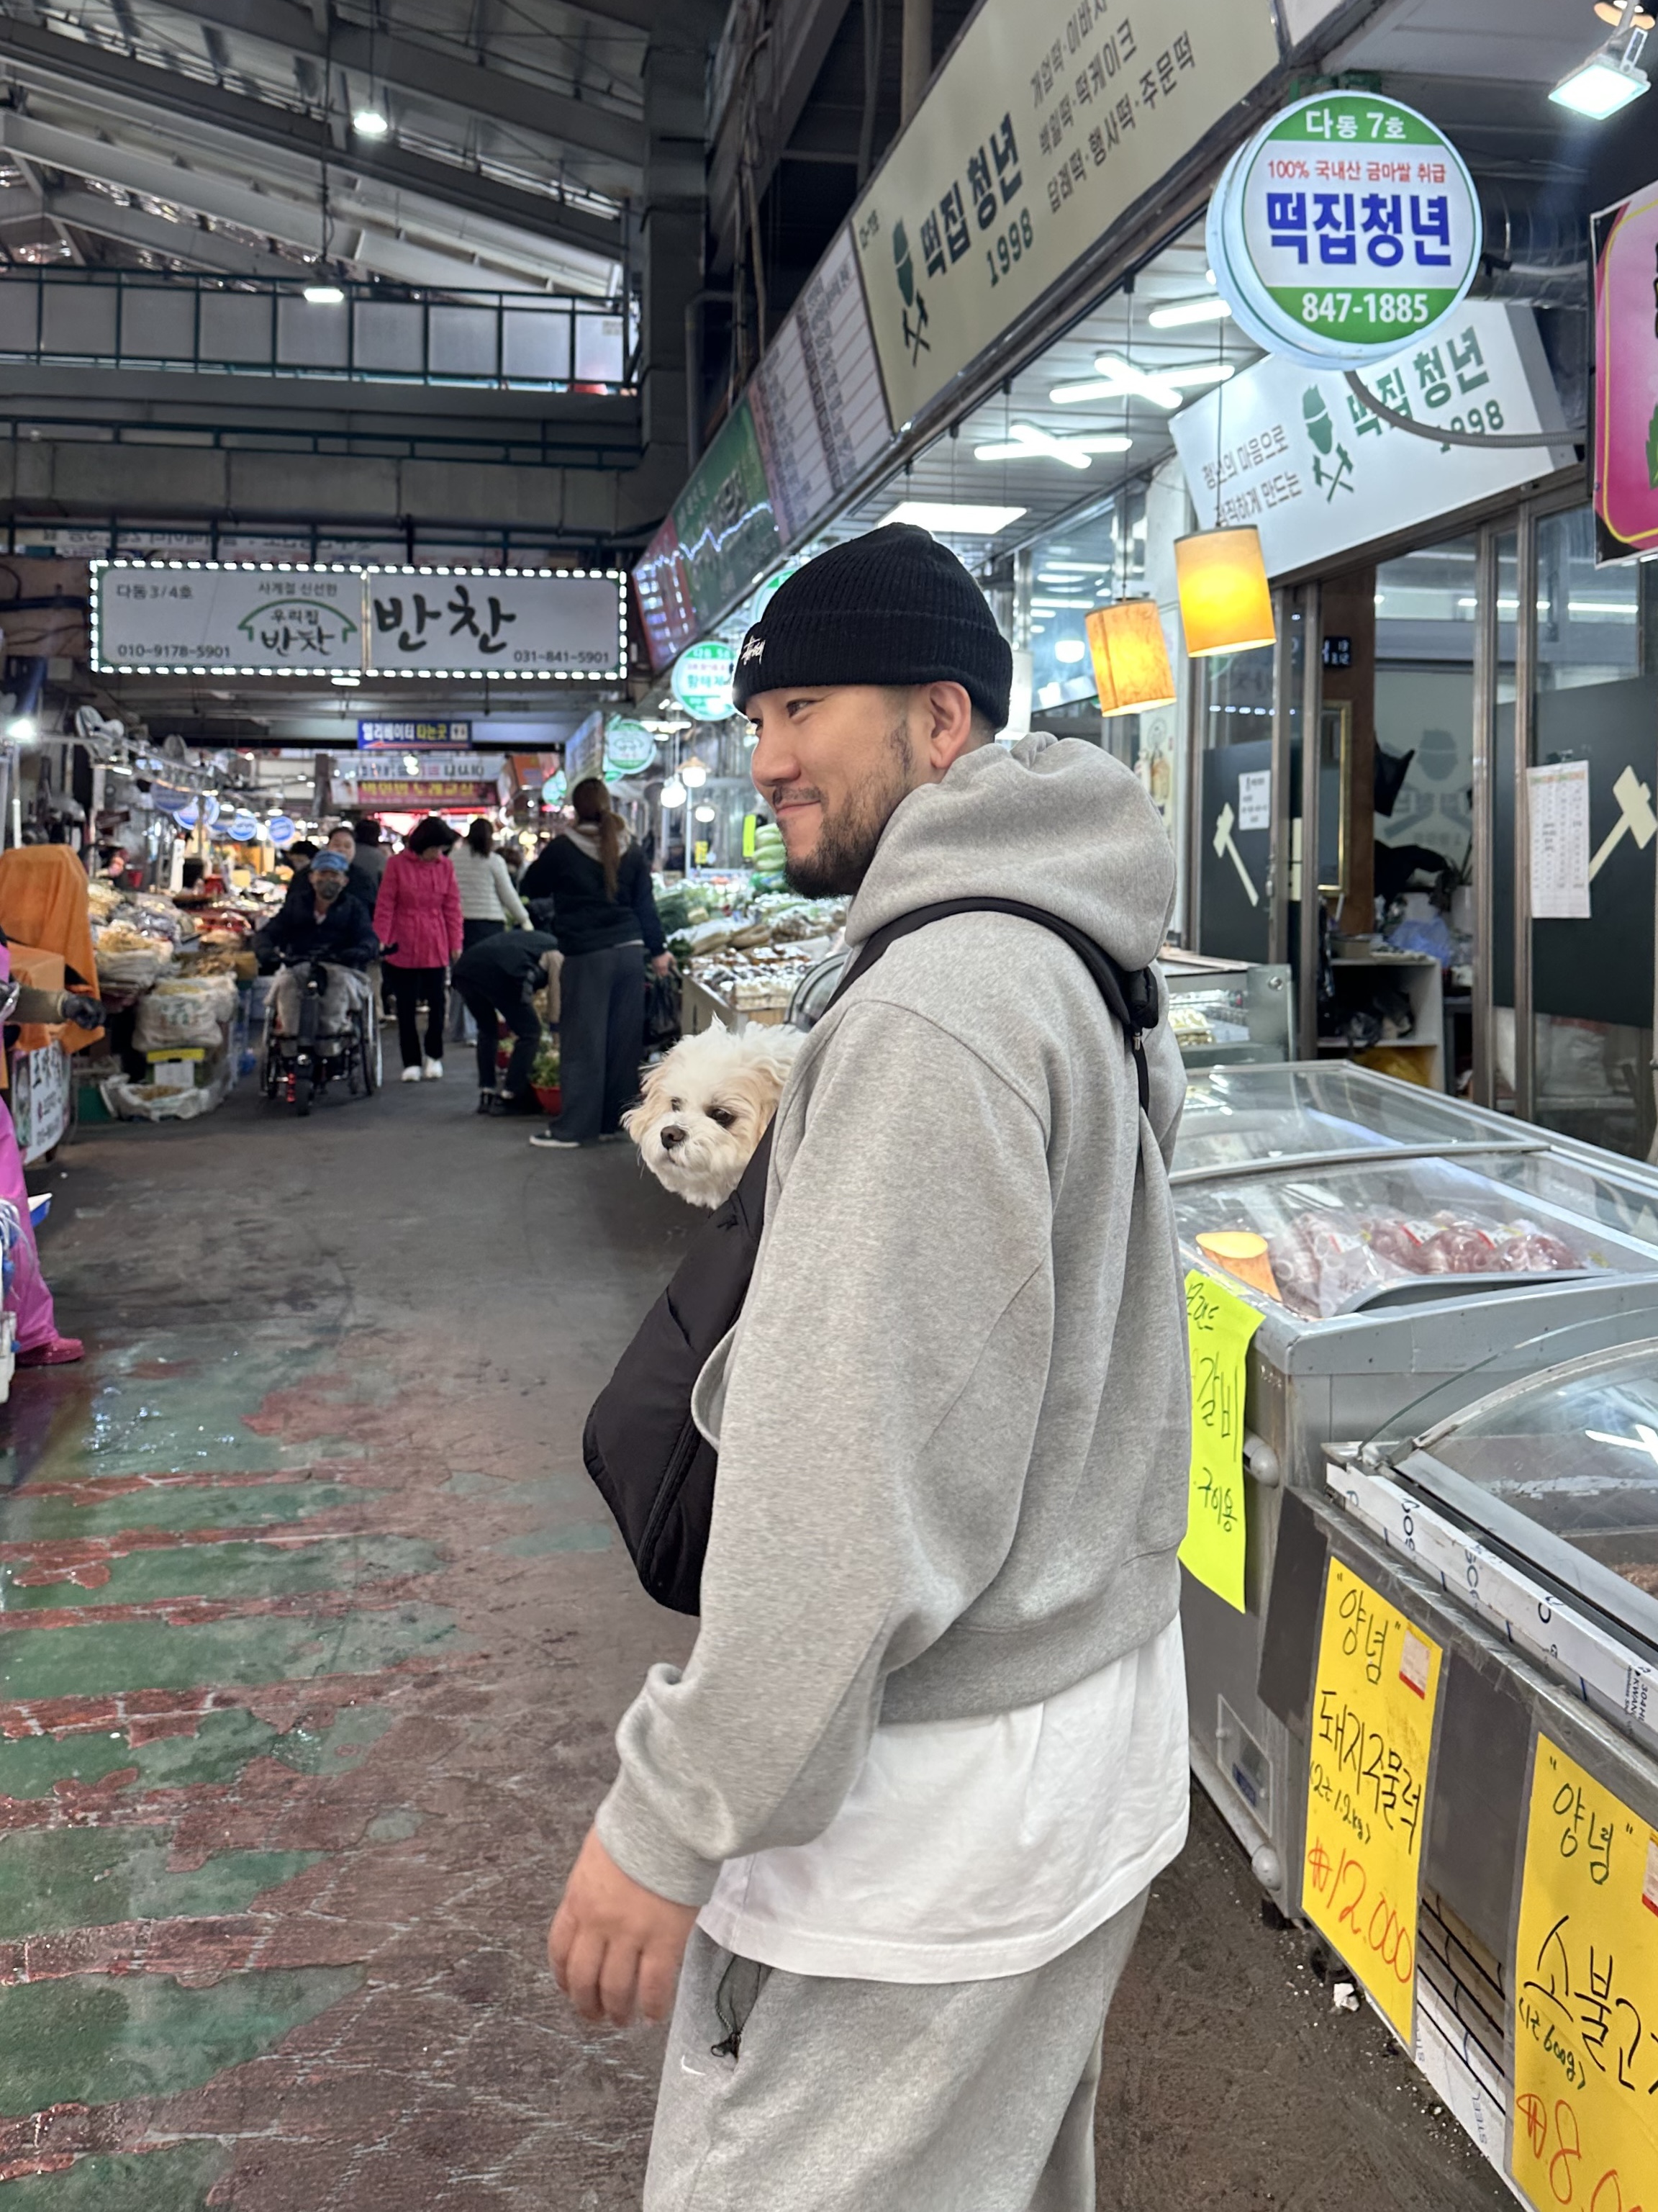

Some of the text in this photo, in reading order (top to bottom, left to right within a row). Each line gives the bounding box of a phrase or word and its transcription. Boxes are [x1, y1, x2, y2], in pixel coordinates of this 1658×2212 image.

[1305, 109, 1407, 139] 다동 7호
[1268, 160, 1446, 184] 100% 국내산 금마쌀 취급
[1267, 192, 1451, 267] 떡집청년
[986, 207, 1033, 288] 1998
[1302, 292, 1429, 323] 847-1885
[1440, 399, 1504, 453] 998
[1237, 424, 1289, 471] 마음으로
[1261, 471, 1302, 508] 만드는
[258, 582, 296, 596] 사계절
[271, 608, 320, 625] 우리집
[373, 584, 516, 654] 반찬
[261, 626, 335, 656] 반찬
[513, 651, 609, 664] 031-841-5901
[1523, 1915, 1658, 2095] 소불고
